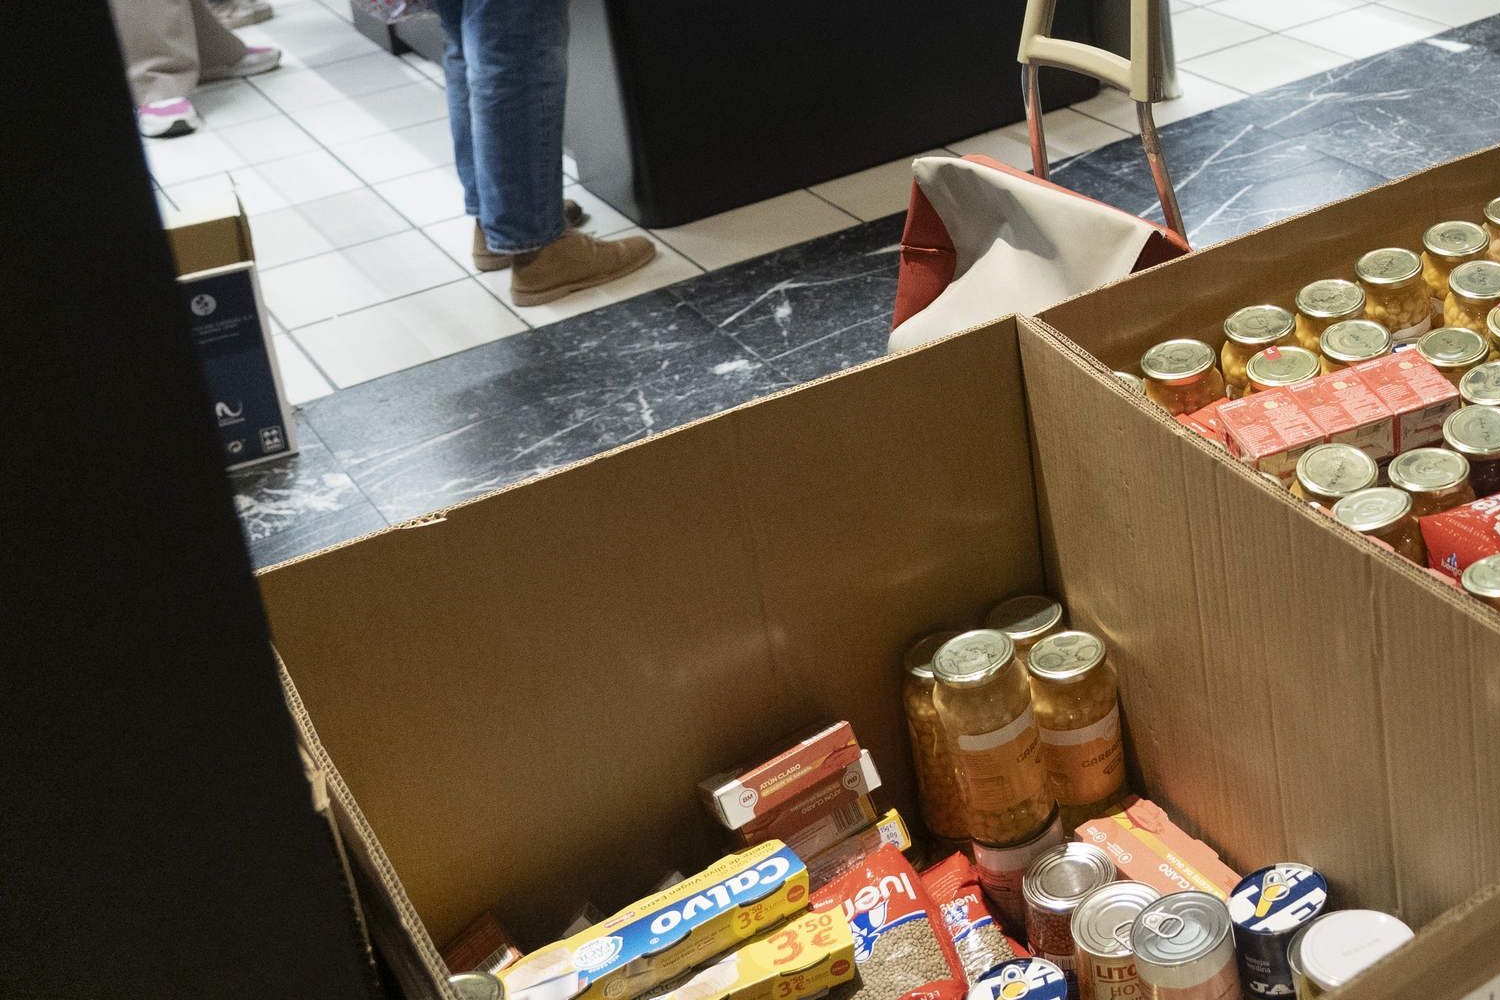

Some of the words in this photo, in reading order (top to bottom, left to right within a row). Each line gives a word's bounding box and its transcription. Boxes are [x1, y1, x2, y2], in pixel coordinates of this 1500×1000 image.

[759, 776, 778, 791] ATÚN
[777, 763, 801, 780] CLARO
[742, 793, 754, 803] BM
[743, 842, 772, 858] aceite
[728, 857, 741, 867] de
[703, 864, 726, 878] oliva
[1158, 862, 1189, 888] CLARO
[669, 878, 702, 895] Virgen
[640, 894, 668, 911] Extra
[650, 856, 790, 934] Calvo
[809, 898, 835, 911] Oferta
